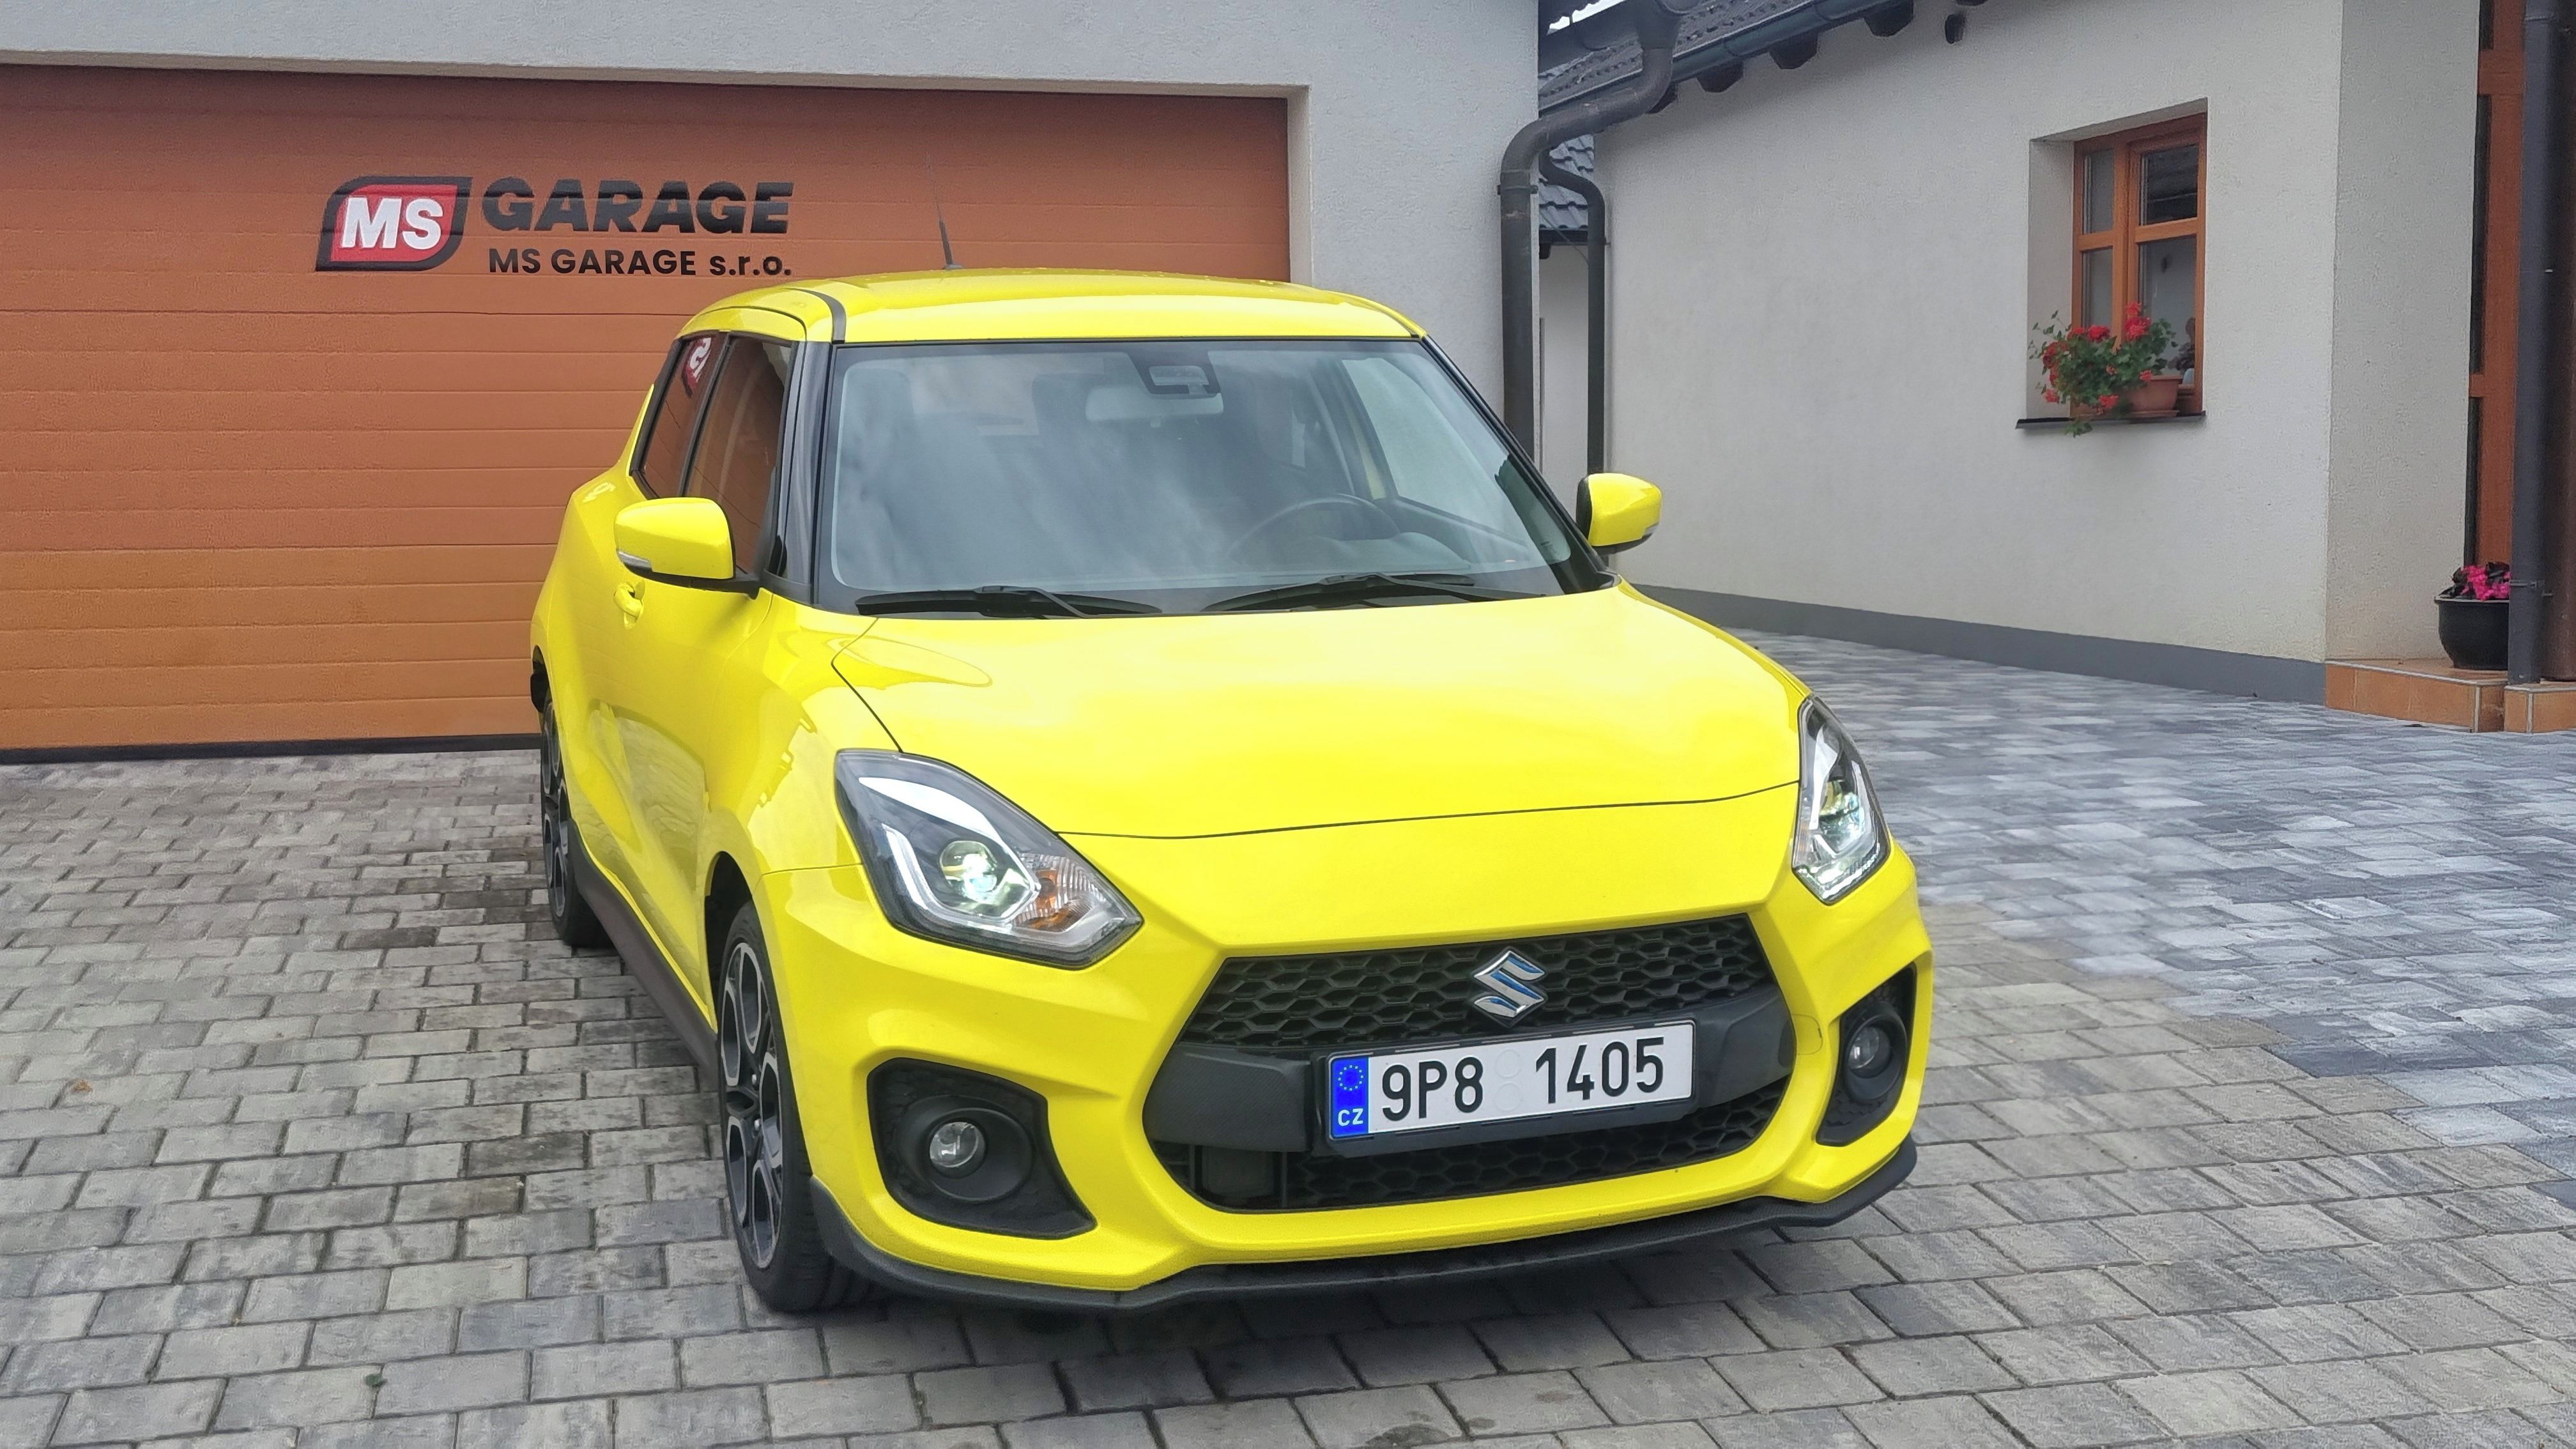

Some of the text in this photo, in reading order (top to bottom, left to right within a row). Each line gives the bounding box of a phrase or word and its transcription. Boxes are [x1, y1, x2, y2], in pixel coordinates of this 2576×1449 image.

[342, 178, 793, 250] MS GARAGE
[490, 249, 792, 276] MS GARAGE s.r.o.
[1381, 1037, 1665, 1122] 9P8 1405
[1338, 1108, 1363, 1126] CZ
